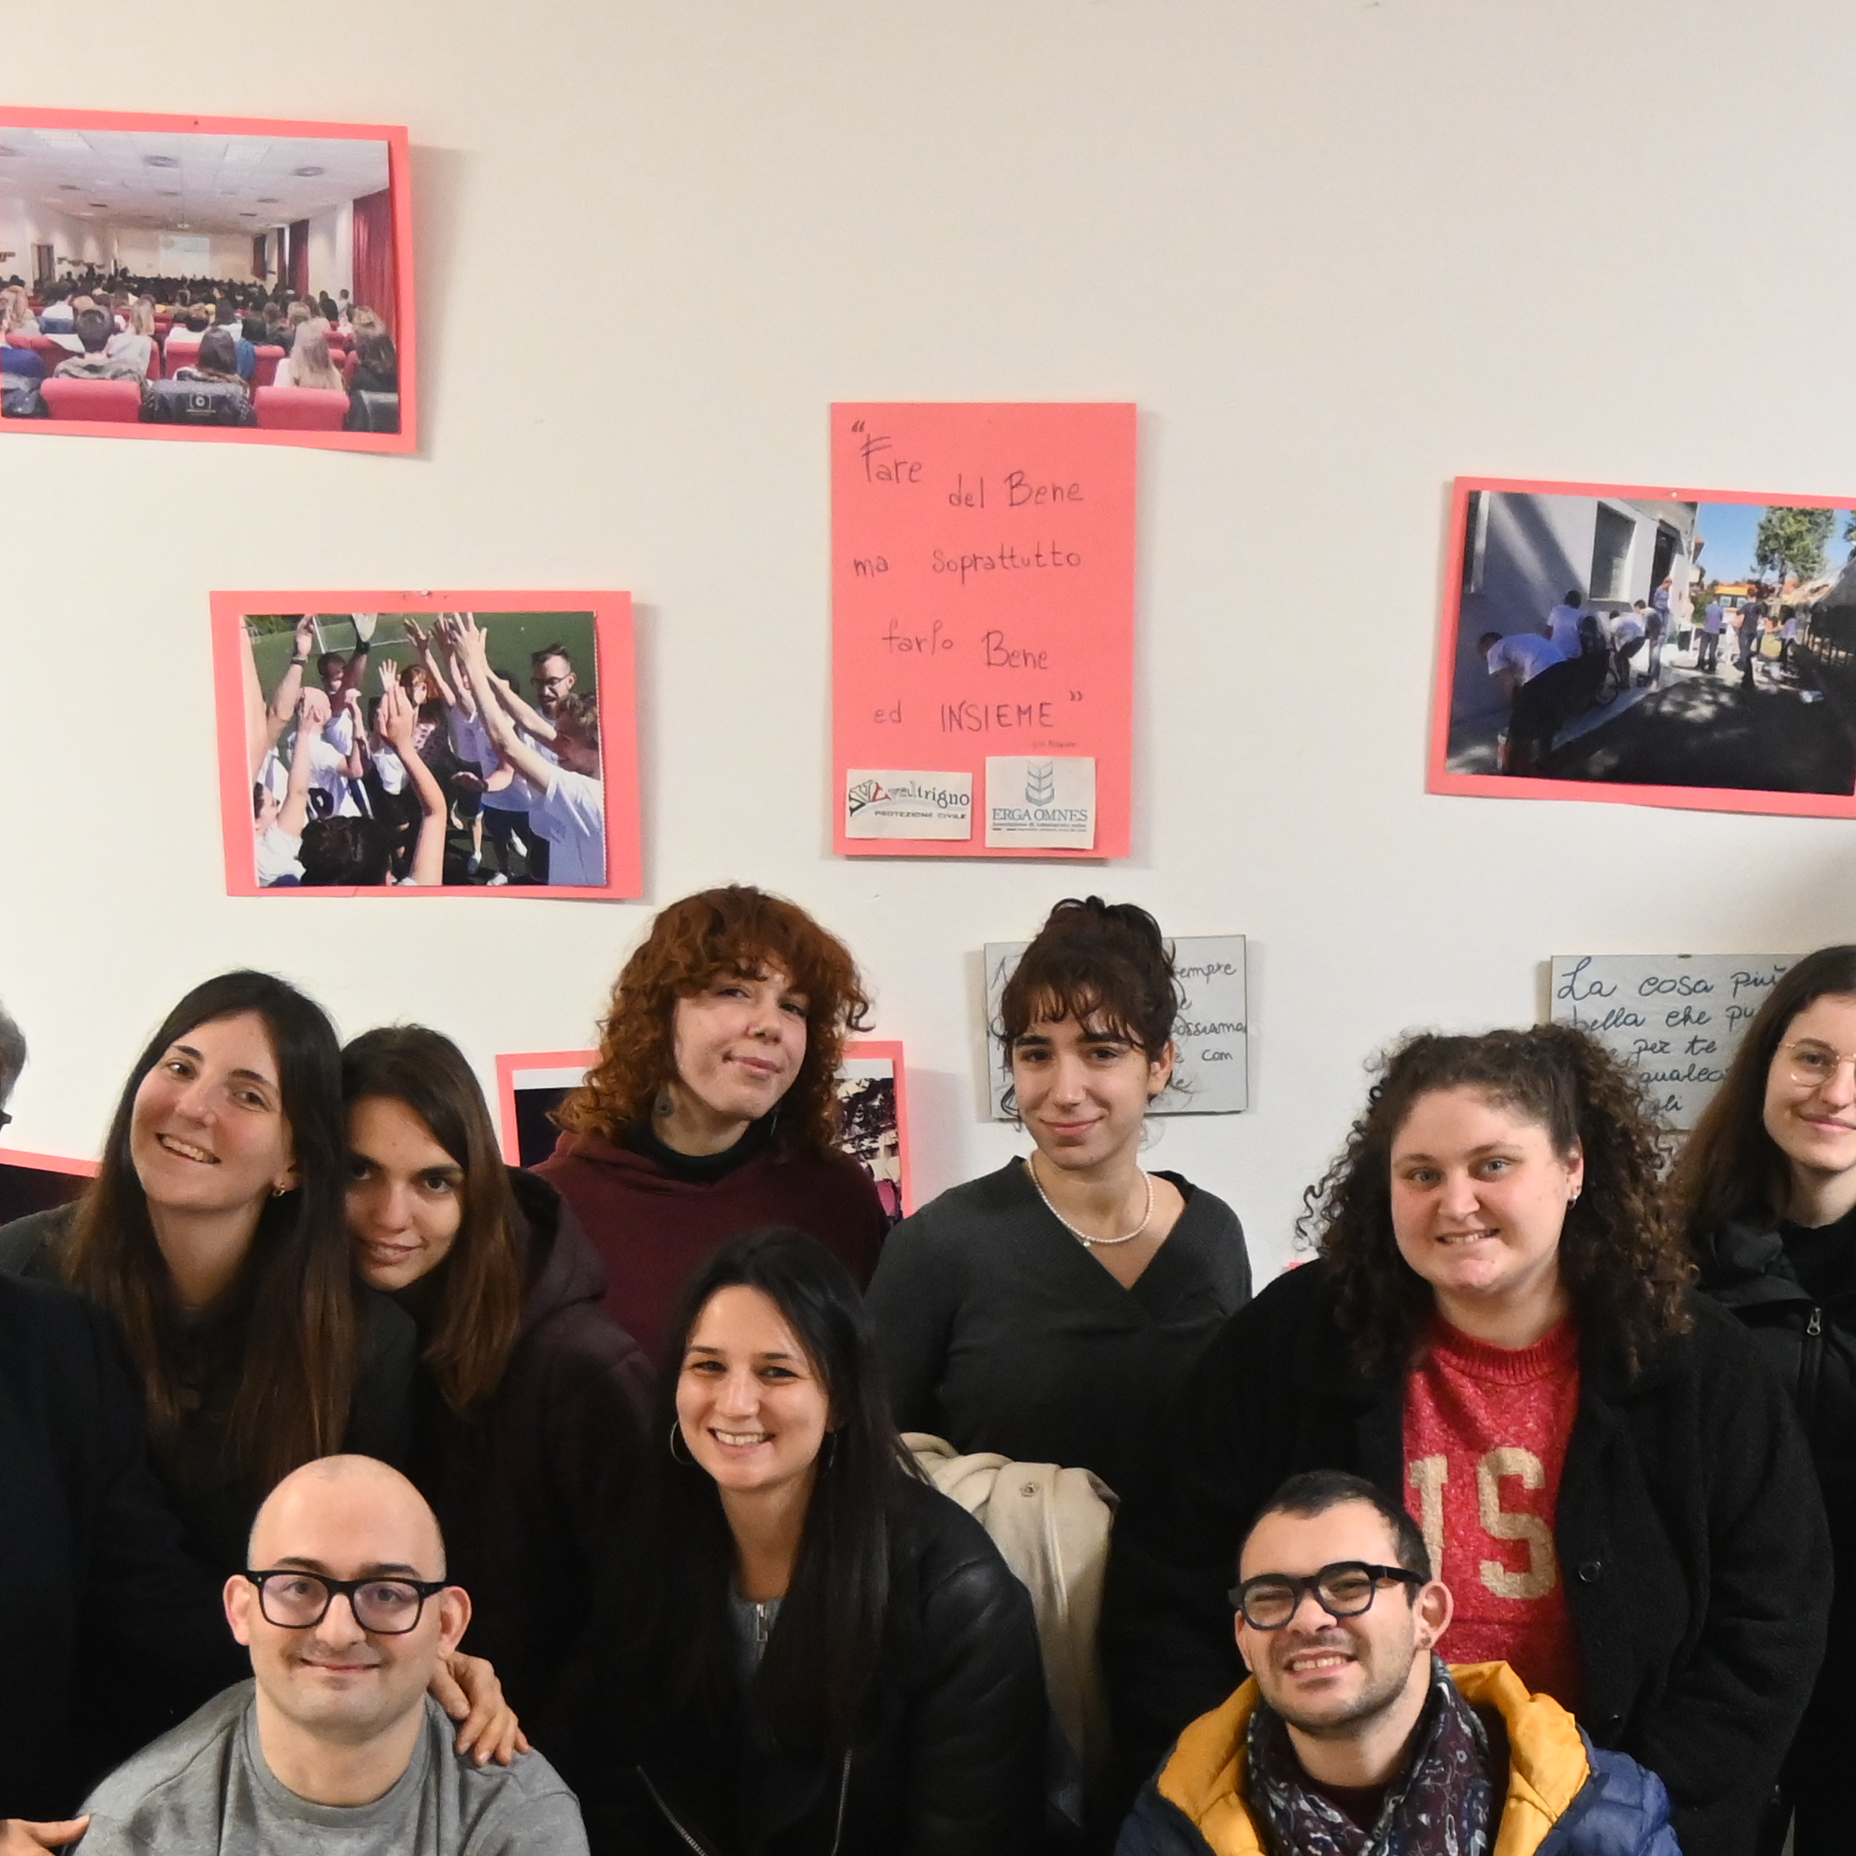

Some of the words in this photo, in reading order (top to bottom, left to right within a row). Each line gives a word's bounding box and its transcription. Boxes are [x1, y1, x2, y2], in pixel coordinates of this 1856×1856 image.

[948, 473, 985, 508] del
[1004, 469, 1084, 507] Bene
[853, 555, 889, 578] ma
[881, 618, 955, 656] farlo
[981, 630, 1049, 671] Bene
[873, 700, 903, 725] ed
[874, 810, 934, 818] PROTEZIONE
[937, 812, 967, 820] CIVILE
[992, 808, 1032, 821] ERGA
[1033, 808, 1088, 823] OMNES
[1175, 962, 1237, 985] empre
[1557, 956, 1618, 1001] La
[1638, 975, 1714, 997] cosa
[1665, 1004, 1713, 1028] che
[1684, 1035, 1717, 1056] te
[1638, 1063, 1730, 1095] qualco
